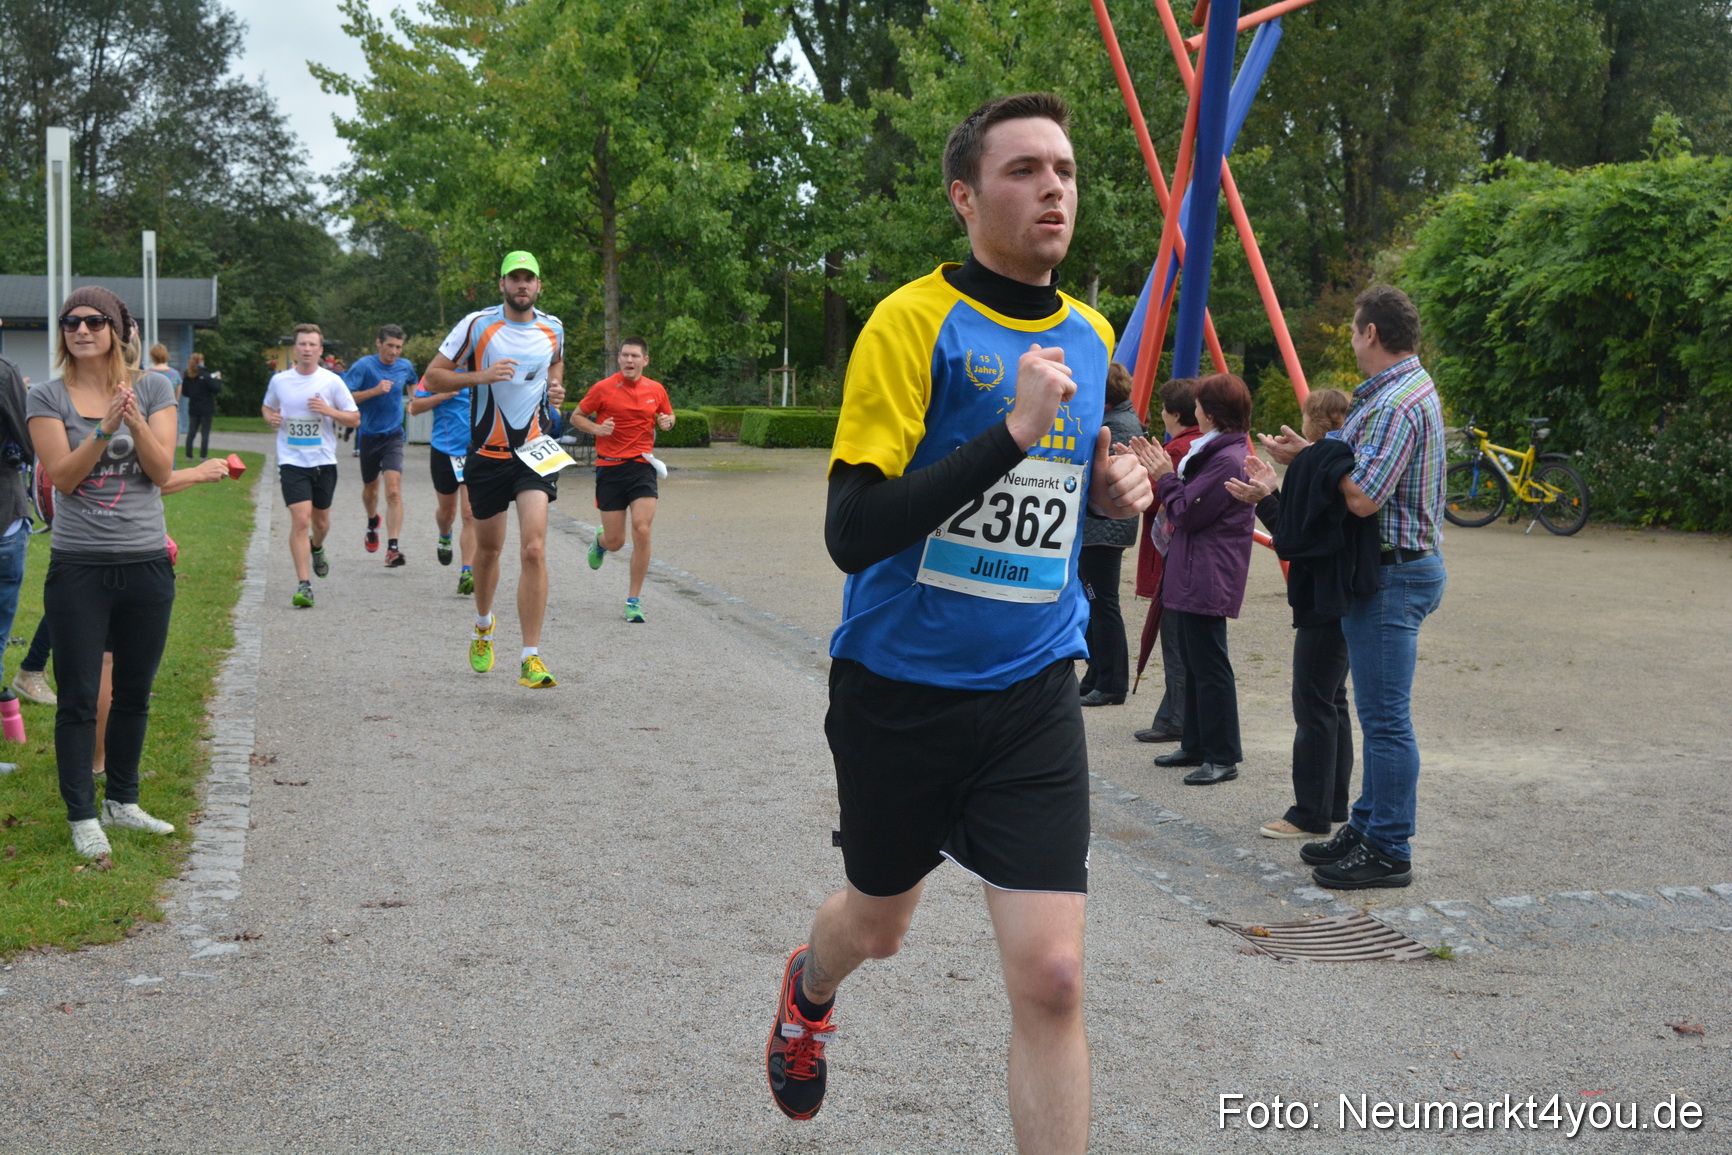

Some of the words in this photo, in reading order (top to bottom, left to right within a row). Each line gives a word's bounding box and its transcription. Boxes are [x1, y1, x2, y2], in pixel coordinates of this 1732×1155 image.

[980, 355, 990, 363] 15
[974, 365, 997, 375] Jahre
[289, 423, 320, 437] 3332
[1003, 472, 1060, 490] Neumarkt
[947, 491, 1067, 550] 2362
[969, 555, 1030, 582] Julian
